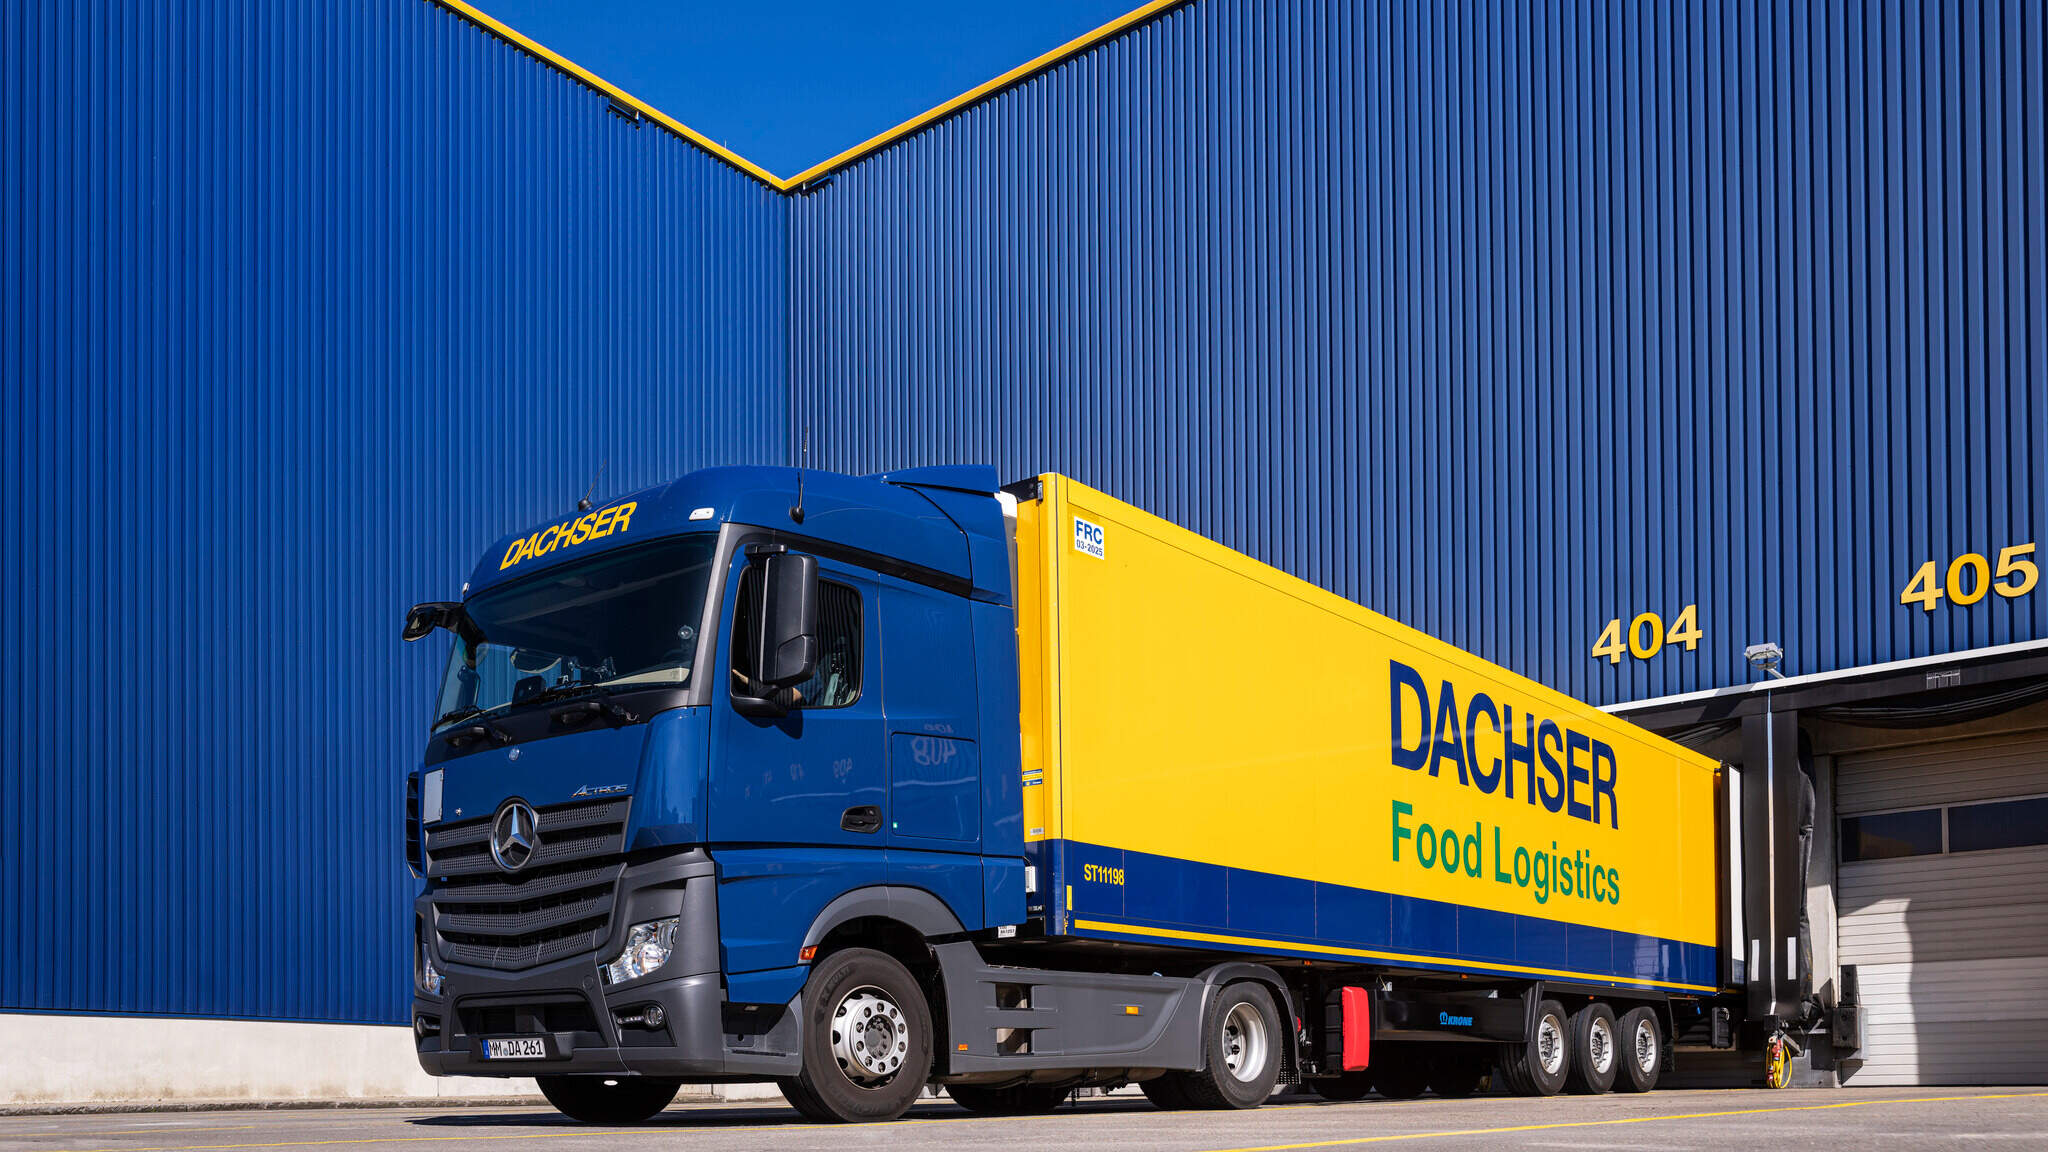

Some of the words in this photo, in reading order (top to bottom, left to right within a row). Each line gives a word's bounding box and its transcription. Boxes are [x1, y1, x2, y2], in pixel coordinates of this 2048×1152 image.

[500, 501, 638, 571] DACHSER
[1076, 519, 1103, 545] FRC
[1076, 539, 1103, 557] 03-2025
[1900, 542, 2040, 611] 405
[1591, 604, 1703, 664] 404
[1390, 658, 1619, 830] DACHSER
[1392, 799, 1483, 879] Food
[1494, 825, 1620, 905] Logistics
[1084, 863, 1125, 886] ST11198
[1448, 1015, 1473, 1027] KRONE
[489, 1041, 503, 1057] MM
[508, 1041, 522, 1056] DA
[522, 1040, 544, 1056] 261
